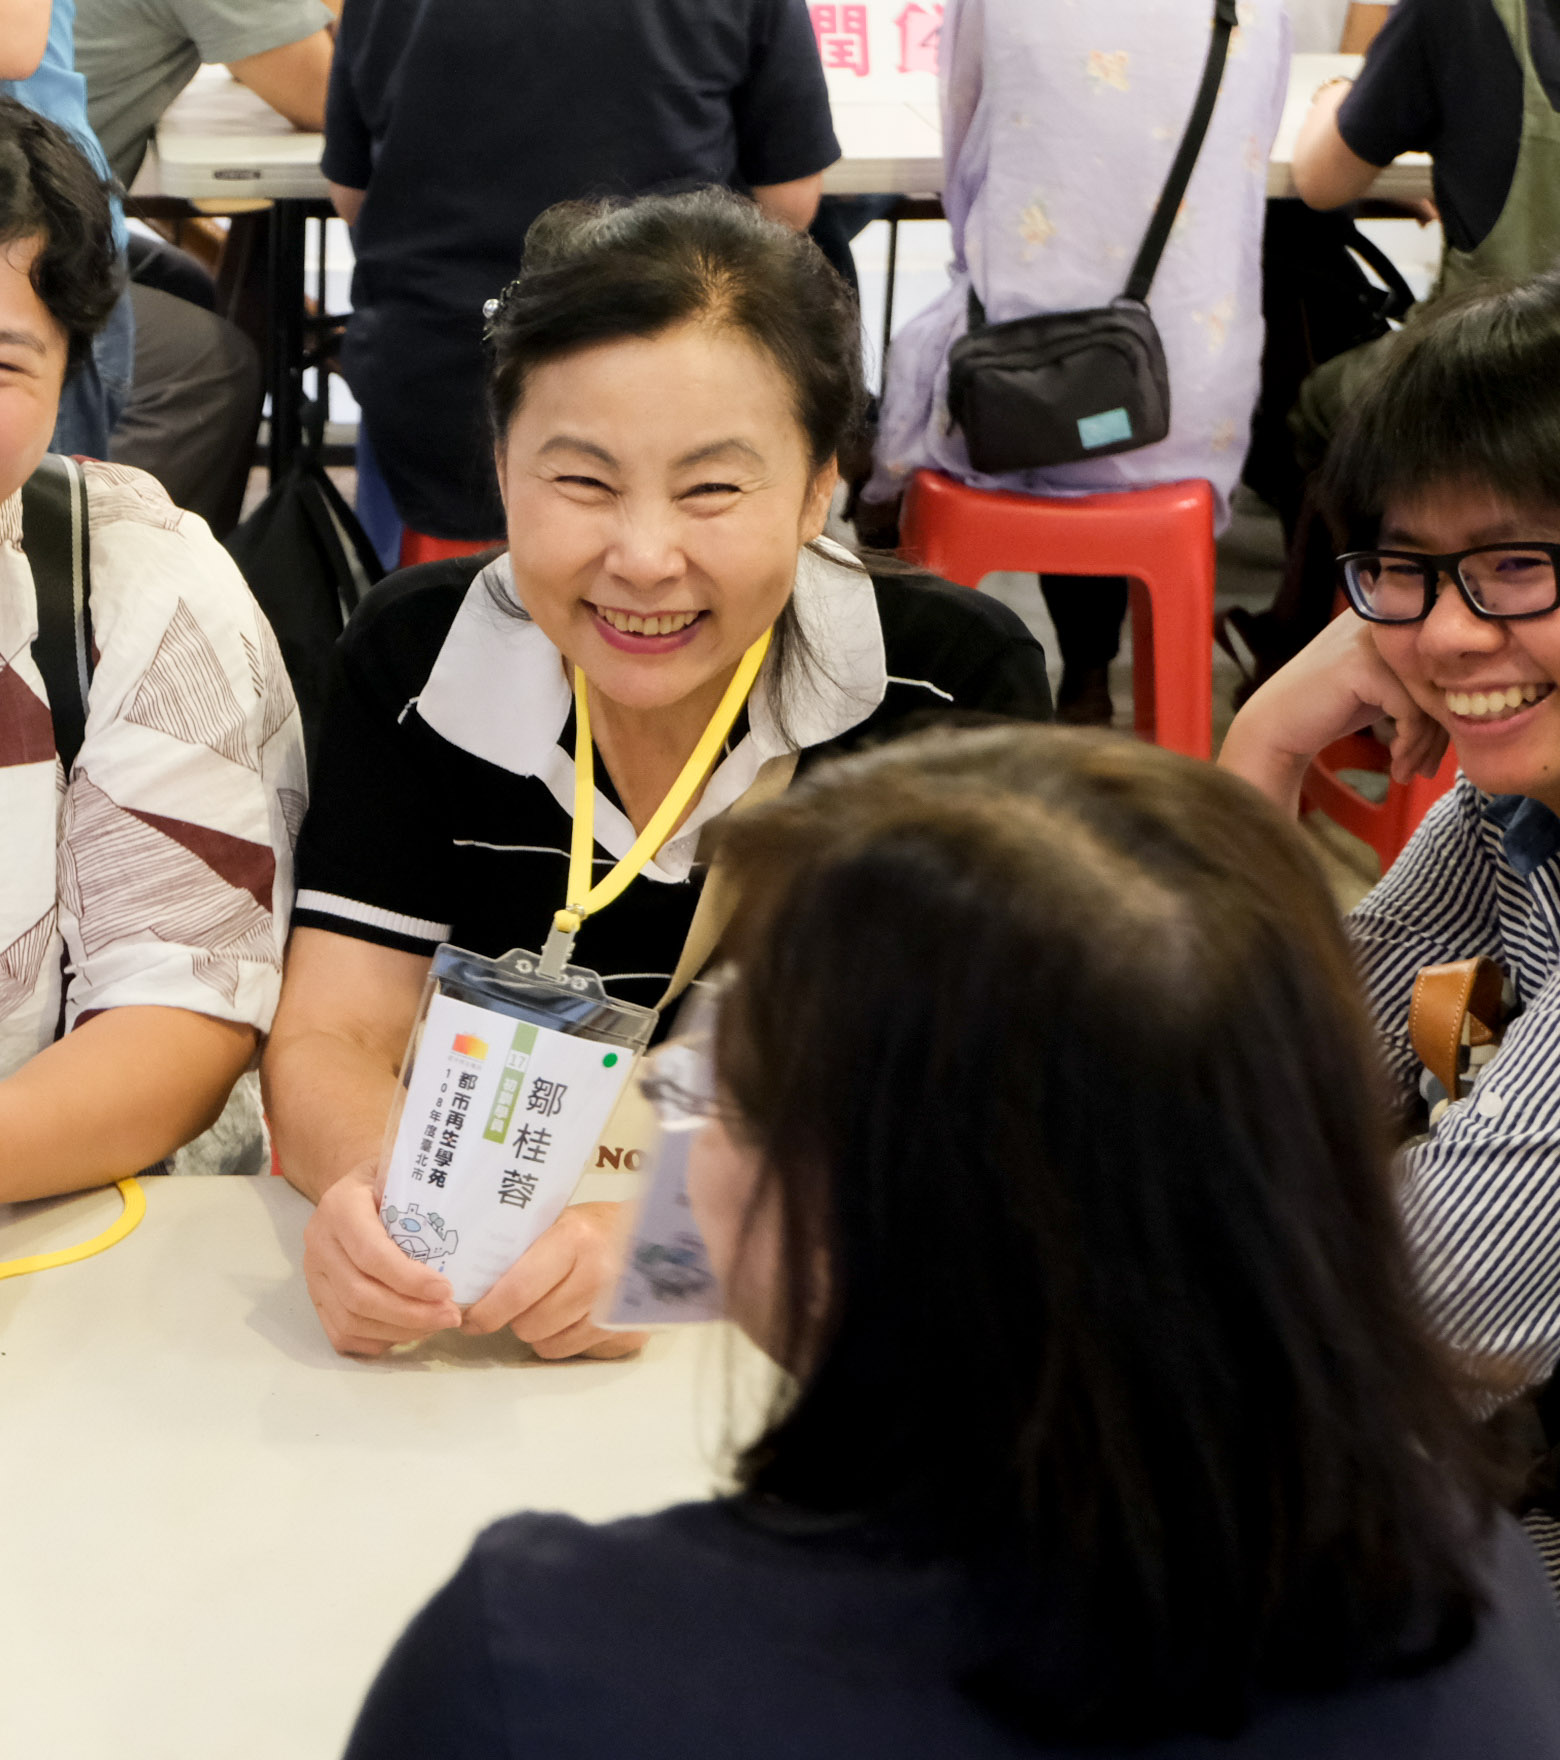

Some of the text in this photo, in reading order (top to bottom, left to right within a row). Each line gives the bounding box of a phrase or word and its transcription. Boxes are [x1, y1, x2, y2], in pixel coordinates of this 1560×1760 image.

[509, 1053, 526, 1069] 17
[427, 1072, 478, 1189] 都市再生學苑
[497, 1076, 568, 1209] 鄒桂蓉
